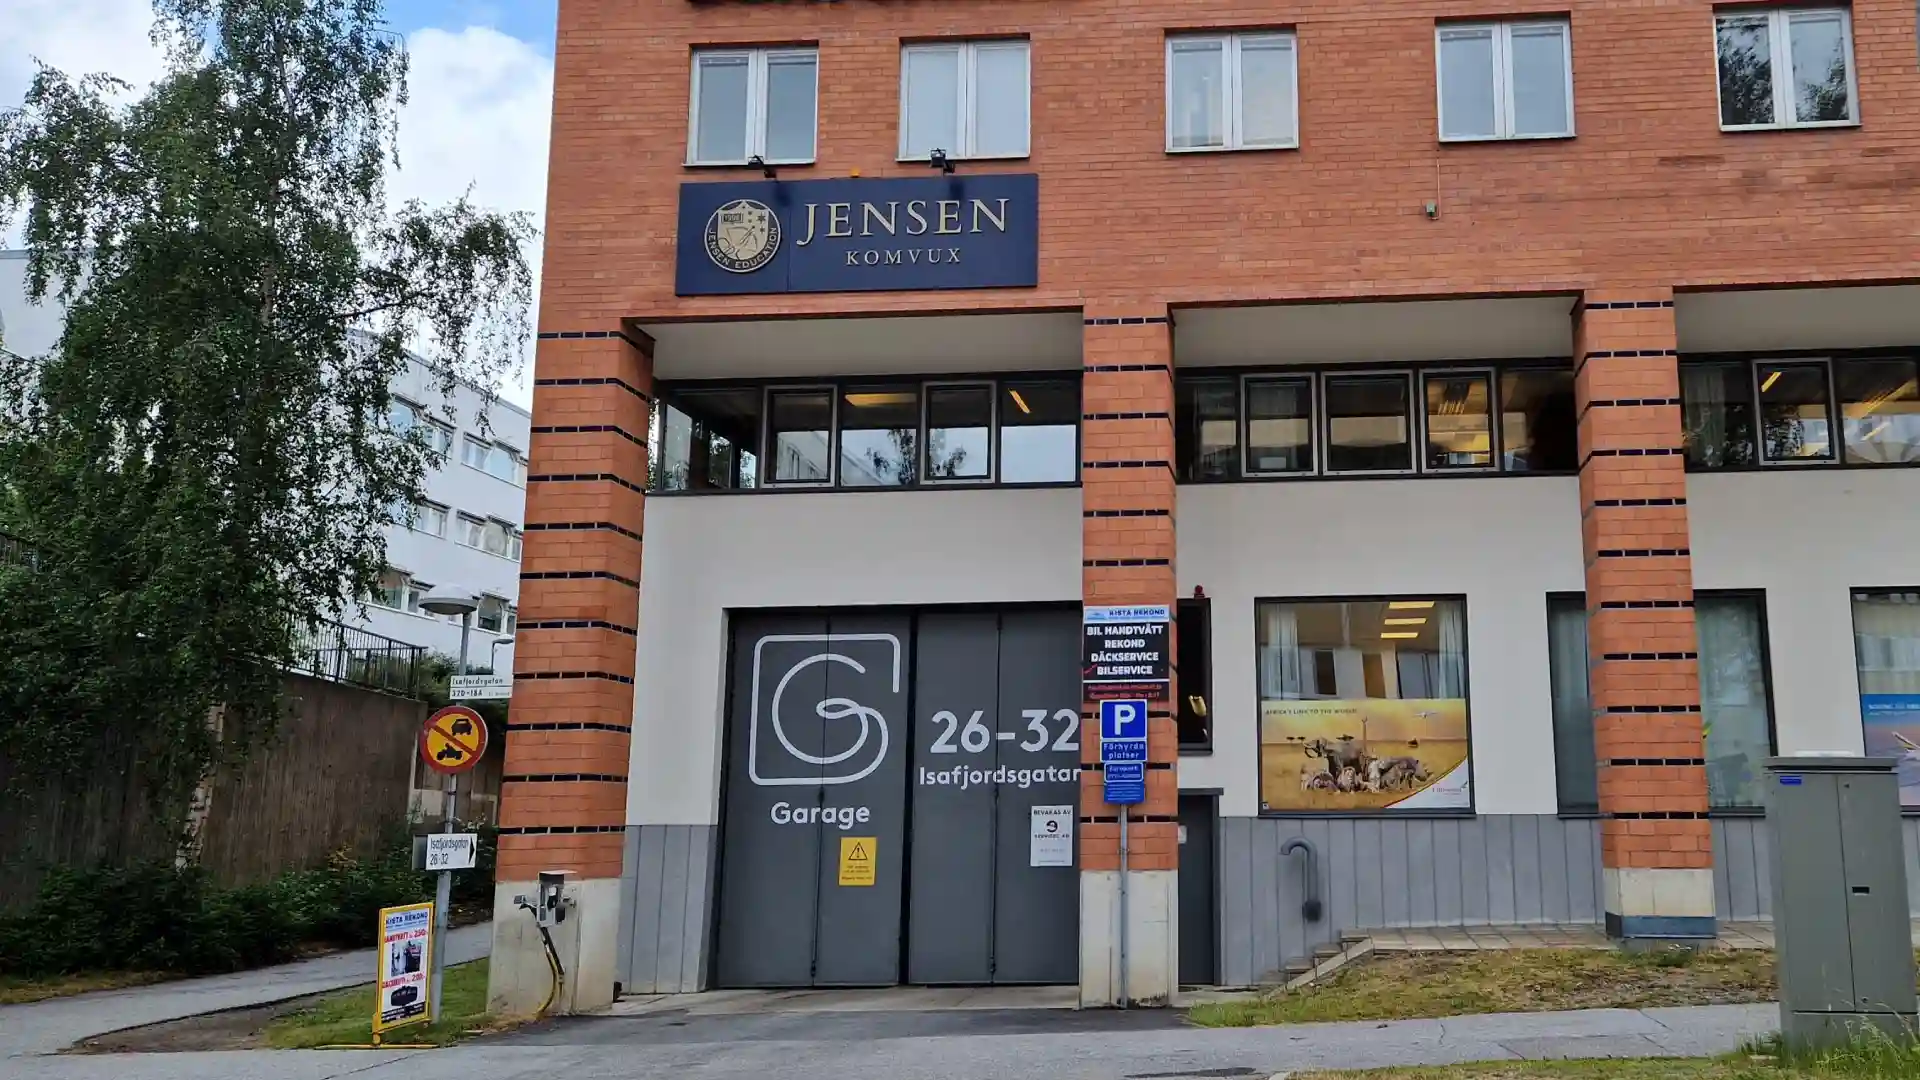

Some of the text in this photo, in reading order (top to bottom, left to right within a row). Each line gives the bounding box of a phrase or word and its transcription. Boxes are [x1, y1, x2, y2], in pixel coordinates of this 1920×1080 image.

[796, 198, 1010, 246] JENSEN
[708, 227, 777, 269] JENSEN EDUCATION
[846, 248, 961, 266] KOMVUX
[1086, 623, 1164, 636] BIL HANDTVÄTT
[1104, 639, 1146, 649] REKOND
[1091, 651, 1159, 662] DÄCKSERVICE
[1096, 665, 1153, 675] BILSERVICE
[452, 675, 503, 687] Isafjordsgatan
[1114, 704, 1136, 735] P
[930, 708, 1080, 754] 26-32
[1108, 752, 1140, 760] platser
[770, 802, 870, 830] Garage
[430, 837, 469, 851] Isafjordsgatan
